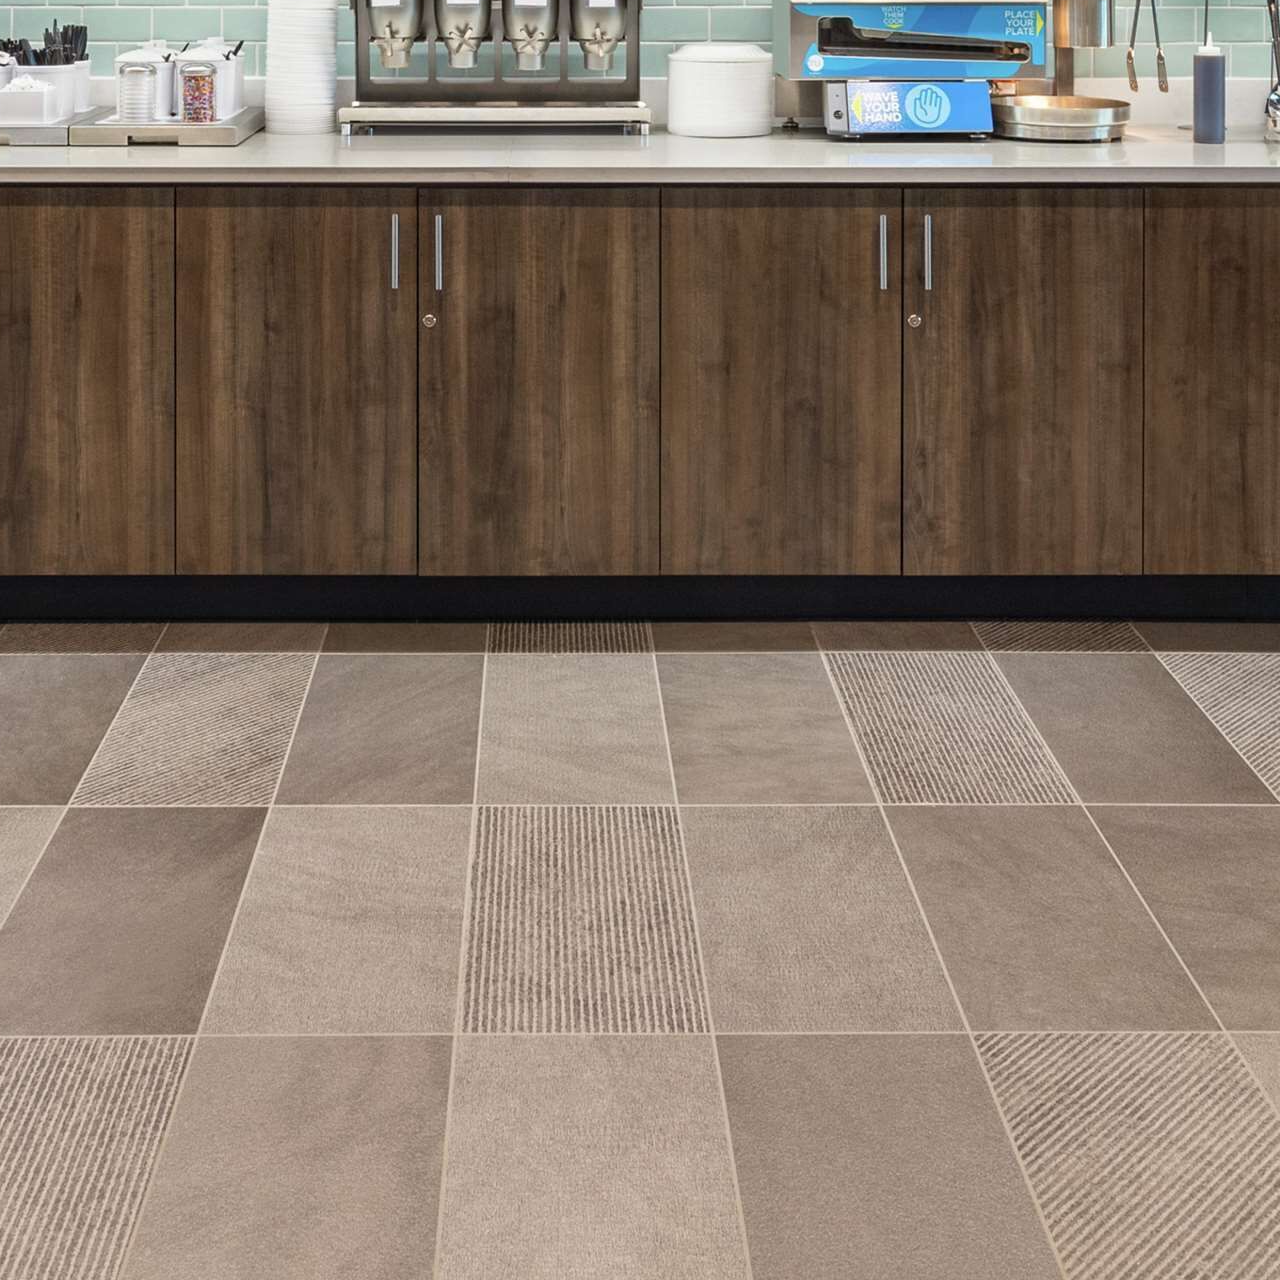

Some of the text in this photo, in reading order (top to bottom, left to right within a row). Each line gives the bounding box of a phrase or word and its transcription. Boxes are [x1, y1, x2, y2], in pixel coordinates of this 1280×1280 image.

[1004, 10, 1035, 18] PLACE
[1006, 19, 1034, 27] YOUR
[1005, 27, 1035, 36] PLATE
[862, 90, 898, 102] WAVE
[864, 102, 900, 113] YOUR
[864, 111, 902, 122] HAND
